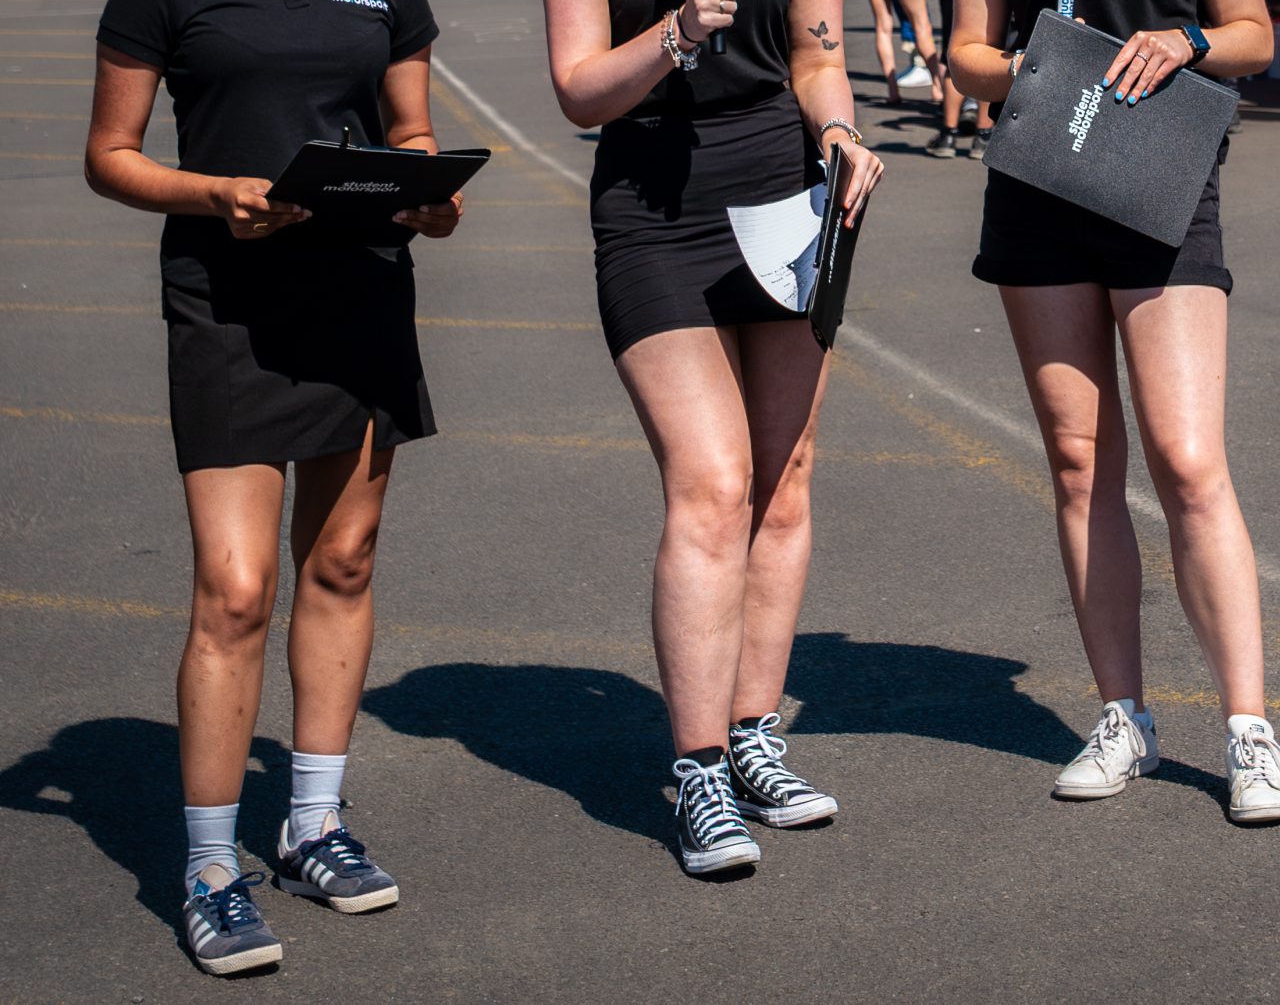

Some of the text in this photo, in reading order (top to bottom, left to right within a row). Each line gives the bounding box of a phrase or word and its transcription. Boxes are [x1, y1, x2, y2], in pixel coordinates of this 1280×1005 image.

[1069, 89, 1093, 135] student
[1072, 84, 1104, 152] motorsport
[323, 185, 400, 193] motorsport
